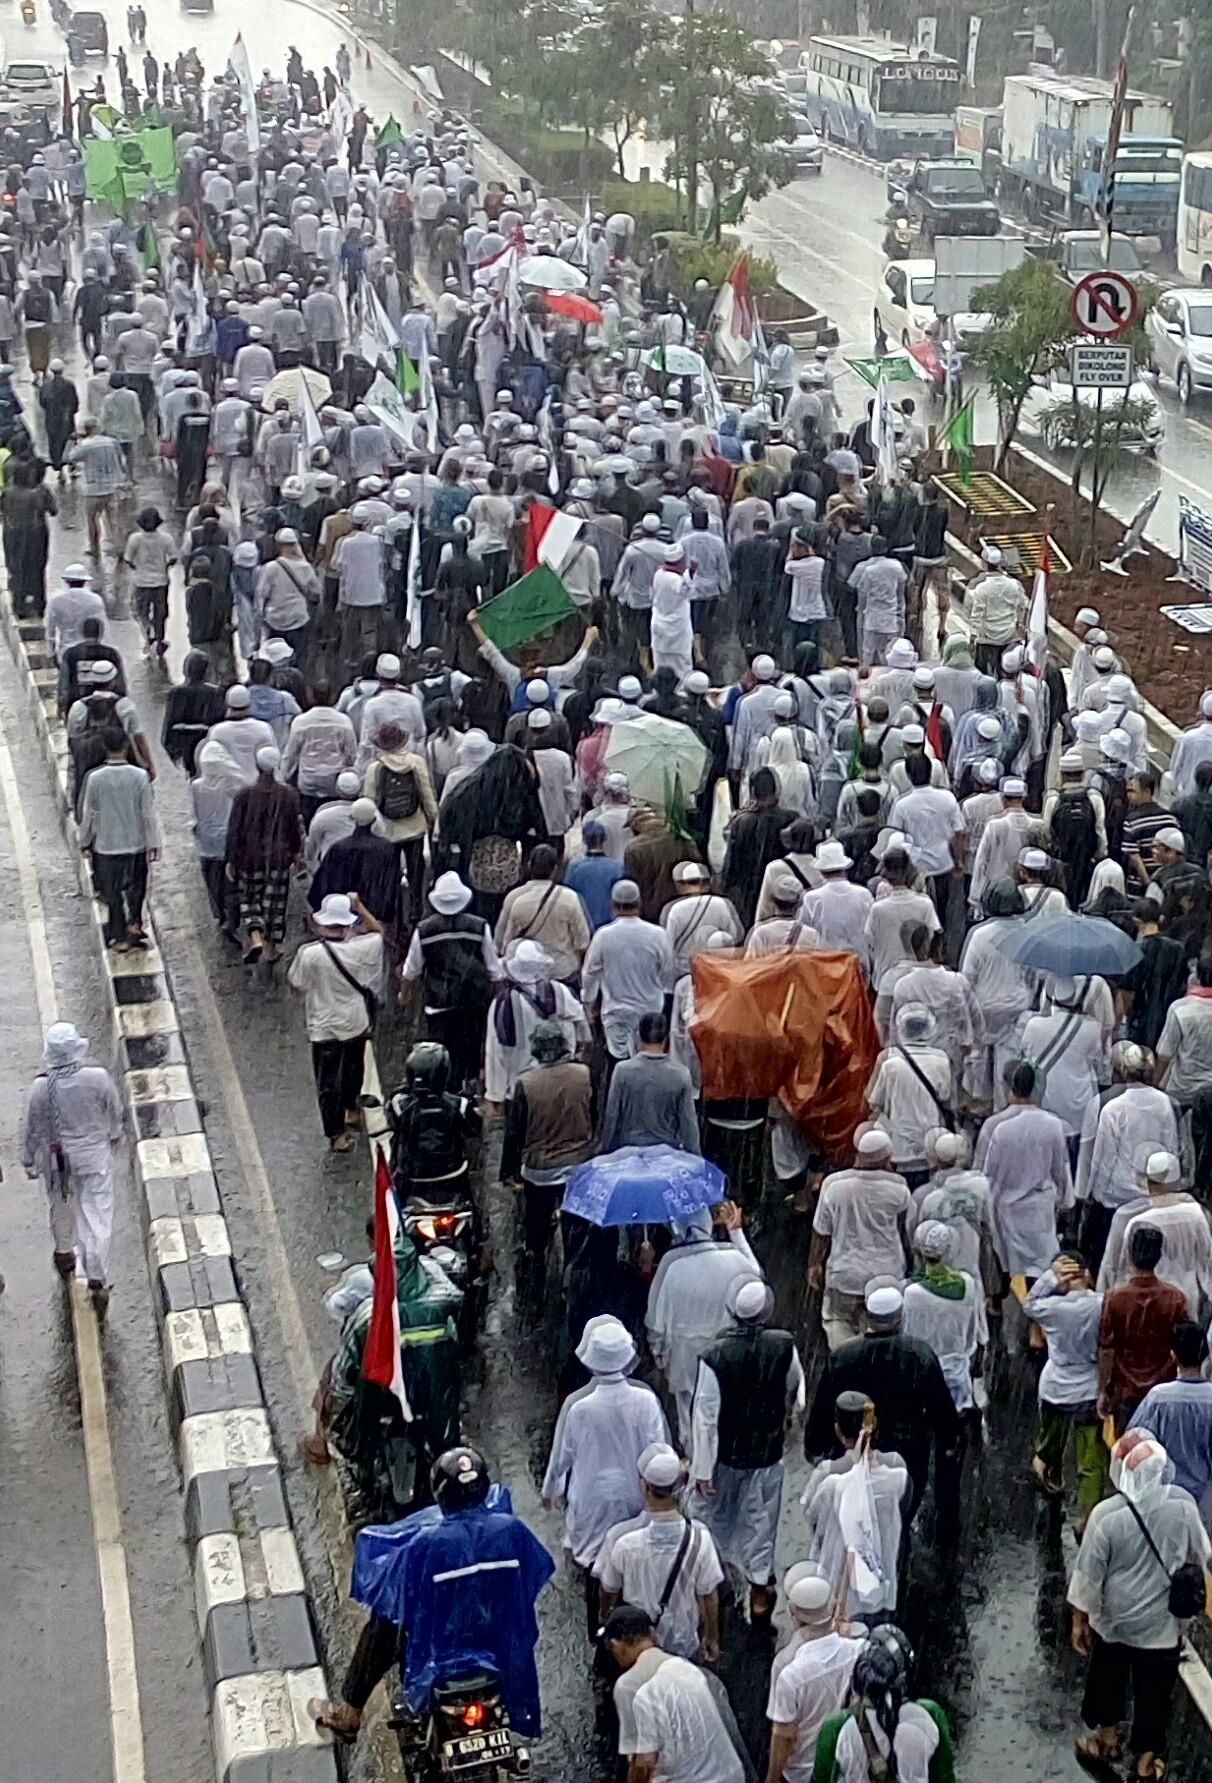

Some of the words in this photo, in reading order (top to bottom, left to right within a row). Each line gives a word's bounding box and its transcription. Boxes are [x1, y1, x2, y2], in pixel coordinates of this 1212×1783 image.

[1078, 351, 1127, 360] BERPUTAR
[1080, 372, 1096, 382] FLY
[1099, 372, 1123, 382] OVER
